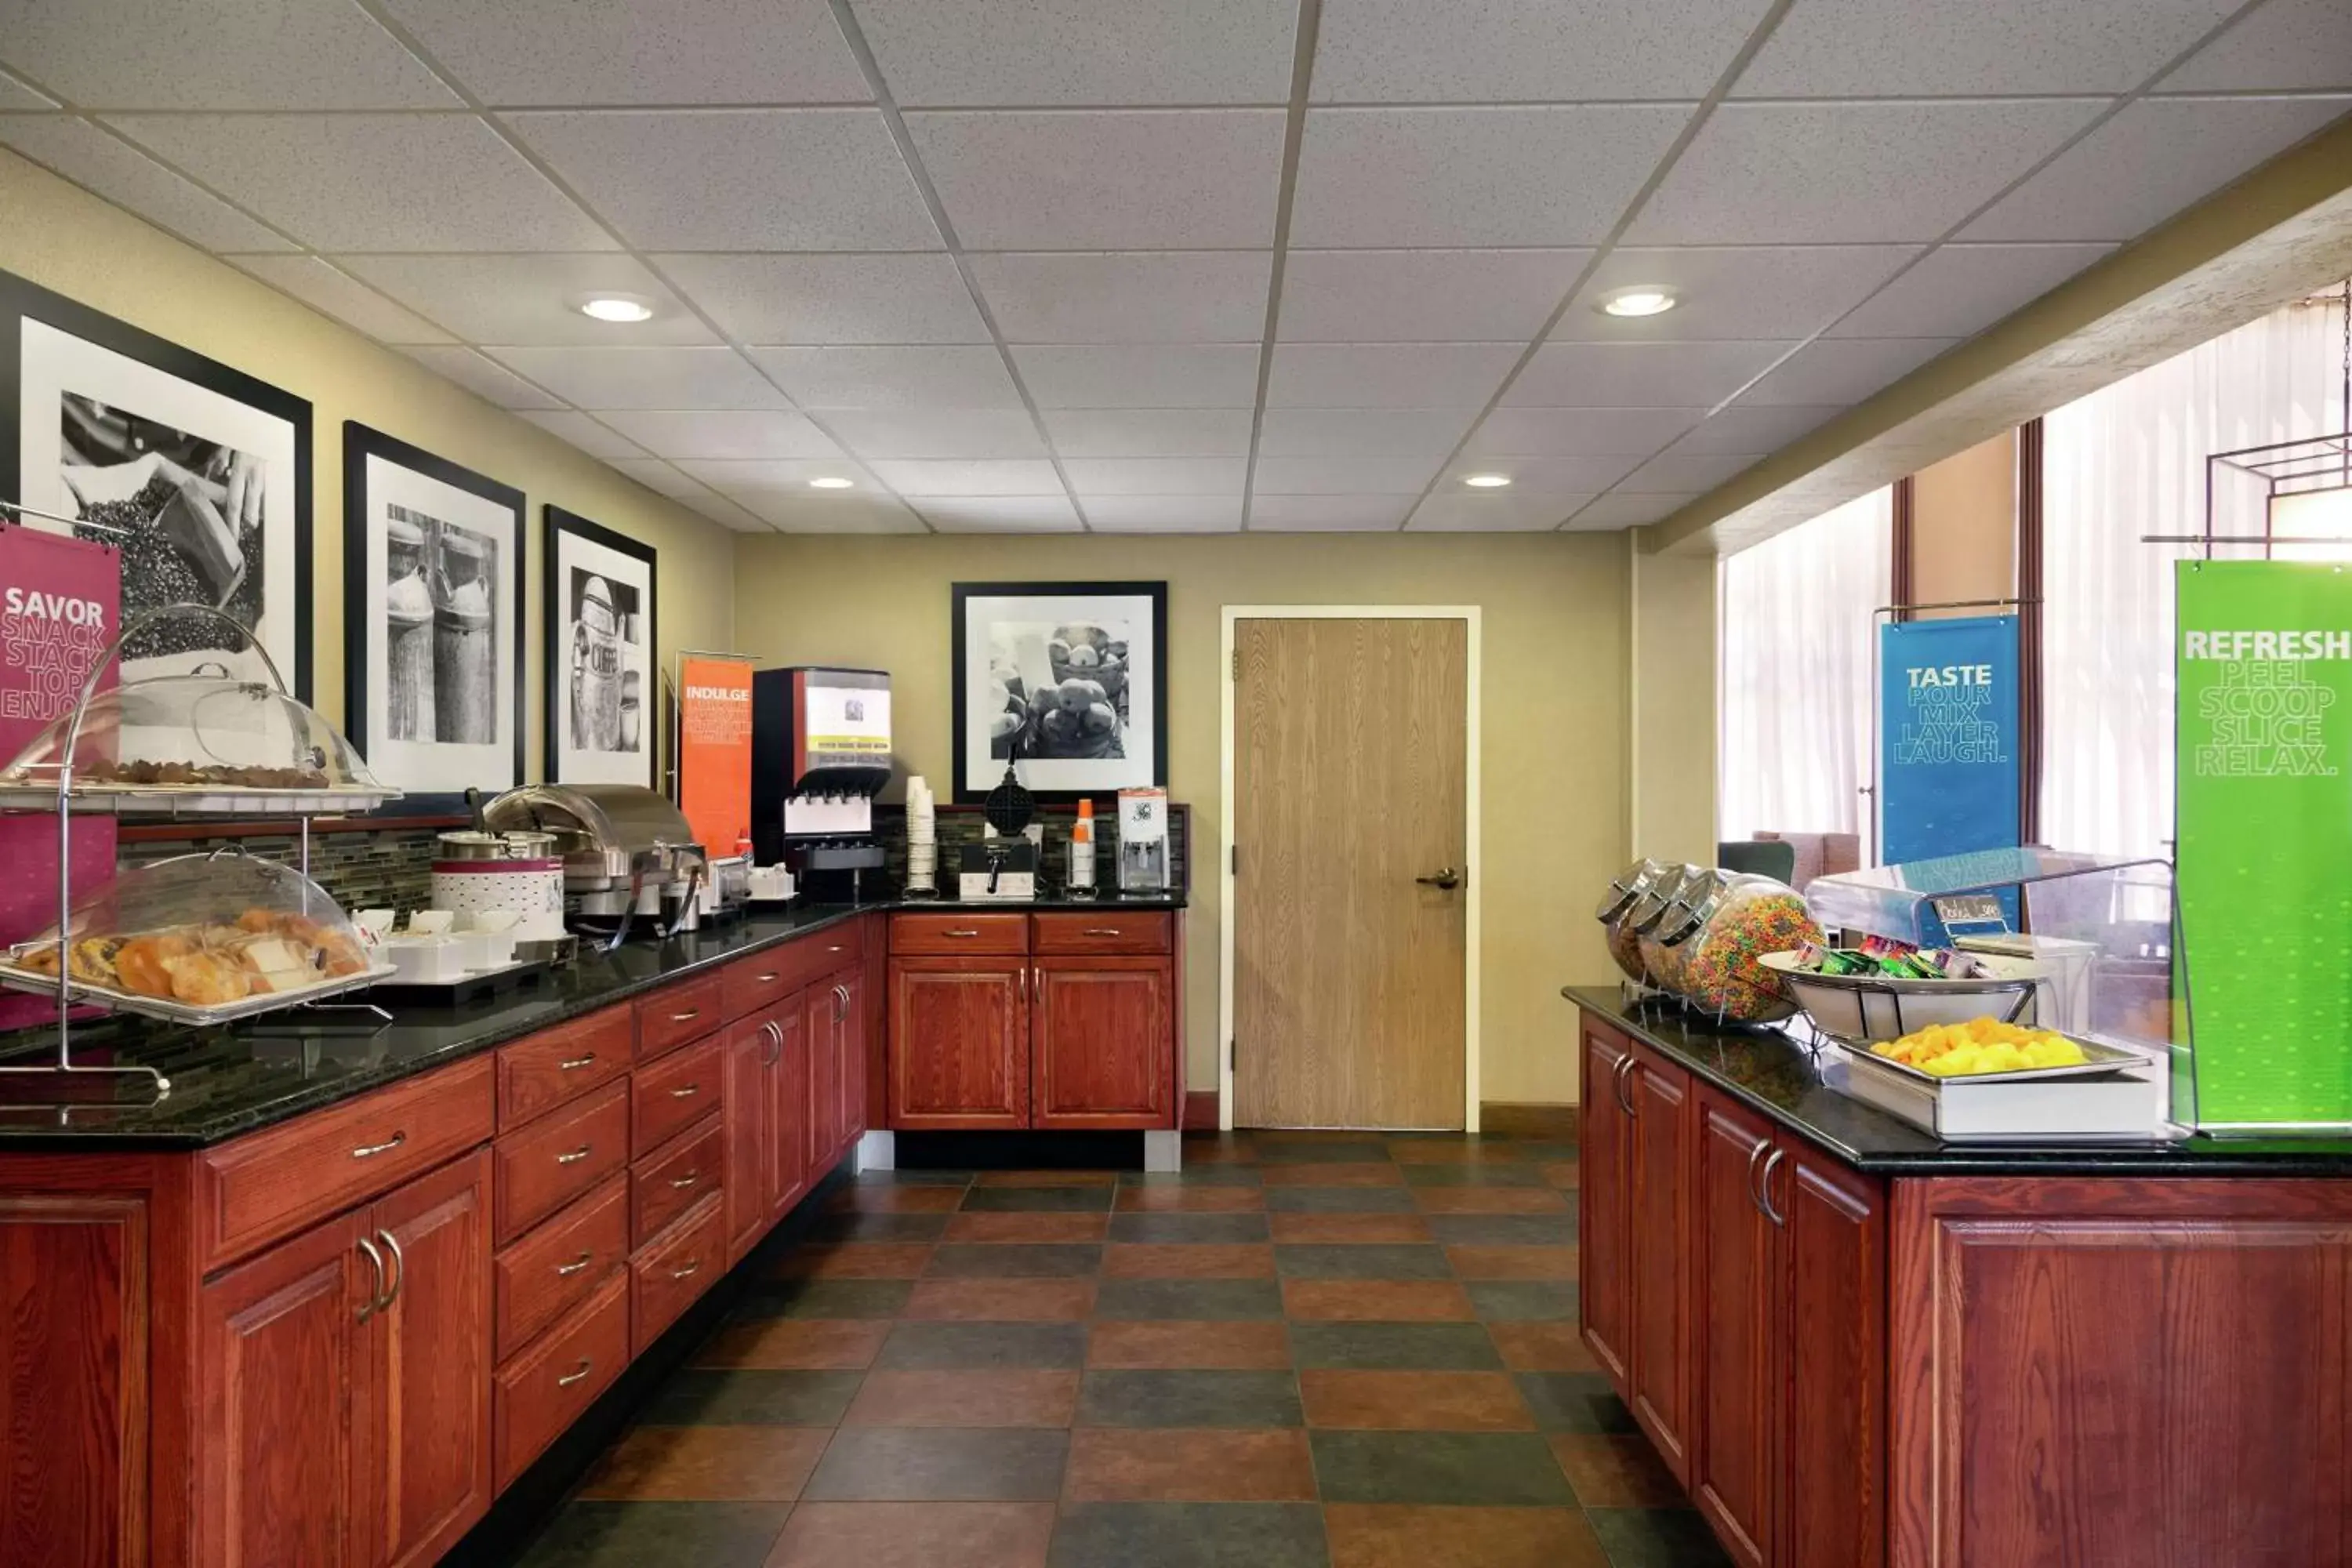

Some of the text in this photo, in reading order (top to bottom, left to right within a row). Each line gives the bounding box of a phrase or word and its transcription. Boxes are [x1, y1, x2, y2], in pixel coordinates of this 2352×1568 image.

[5, 587, 103, 628] SAVOR
[0, 612, 107, 652] SNACK
[2185, 630, 2351, 659] REFRESH
[1906, 665, 1992, 688] TASTE
[2221, 658, 2317, 688] PEEL
[687, 686, 750, 701] INDULGE
[1908, 683, 1992, 706] POUR
[2199, 686, 2336, 718] SCOOP
[1918, 702, 1980, 725] MIX
[1901, 720, 1999, 745] LAYER
[2212, 714, 2323, 746] SLICE
[1893, 739, 2008, 765] LAUGH.
[2196, 744, 2339, 776] RELAX.
